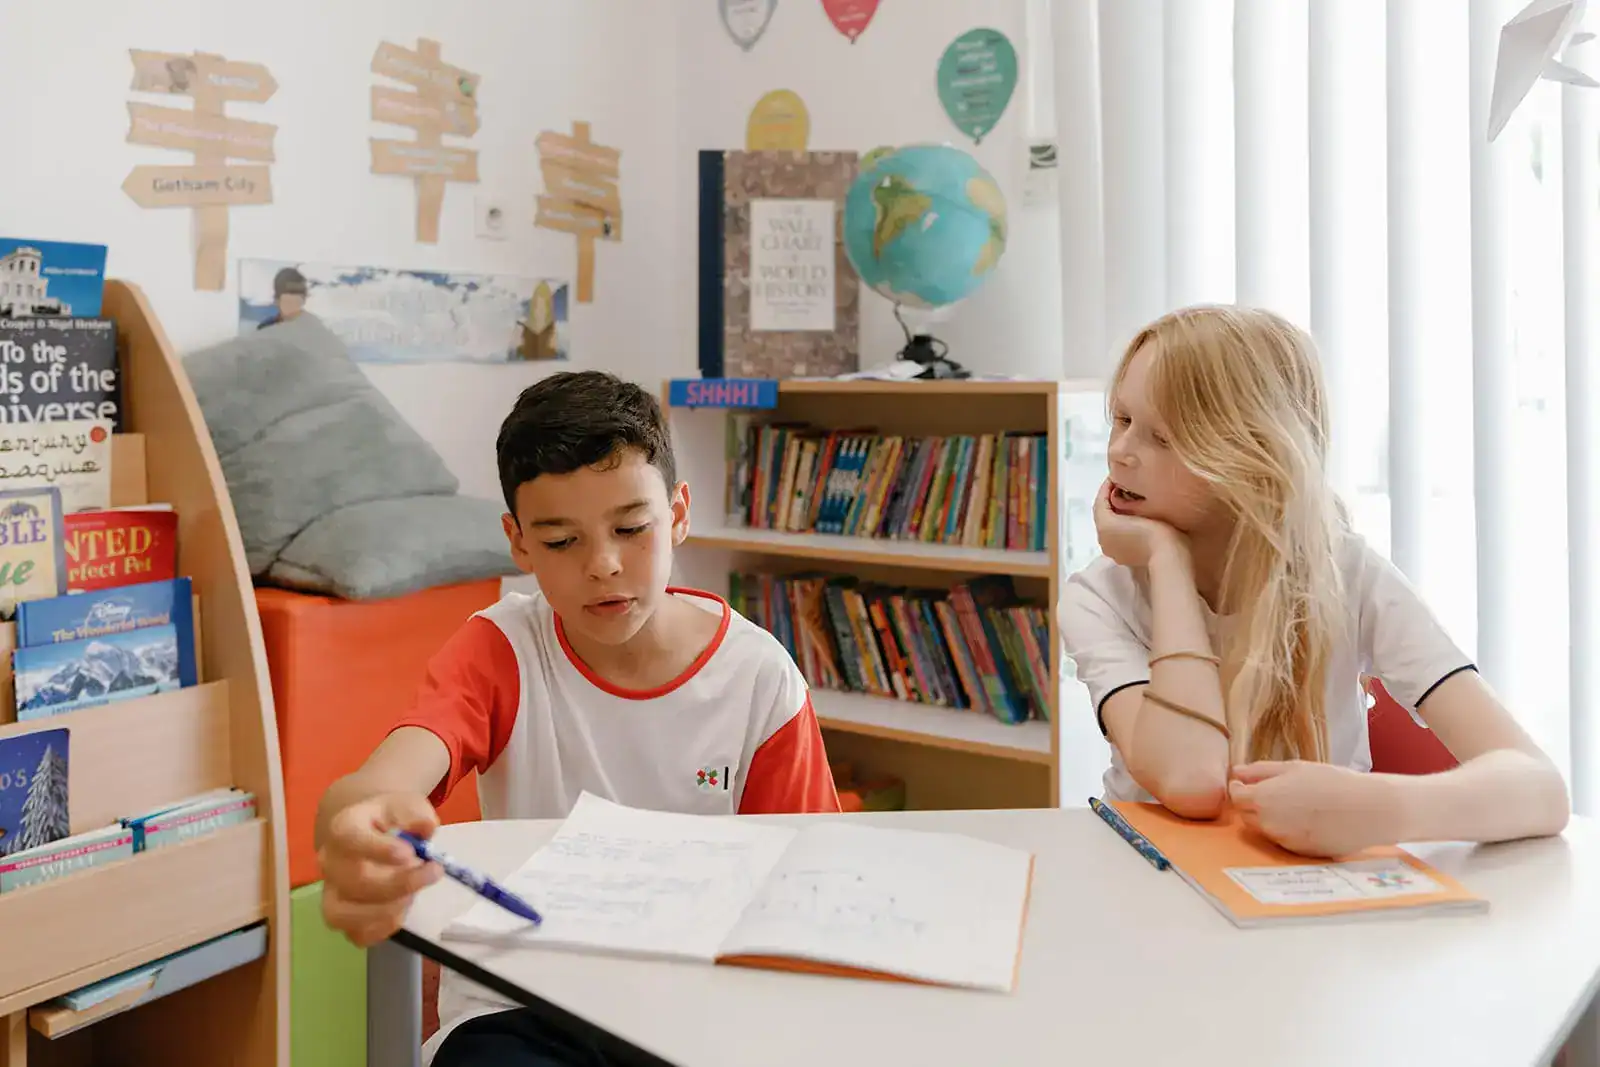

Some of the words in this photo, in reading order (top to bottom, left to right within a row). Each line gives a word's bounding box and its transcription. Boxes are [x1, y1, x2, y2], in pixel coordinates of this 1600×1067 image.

[152, 177, 220, 193] Gotham
[224, 175, 257, 194] City
[767, 217, 815, 233] WALL
[759, 233, 824, 251] CHART
[758, 265, 829, 281] WORLD
[754, 281, 828, 298] HISTORY
[0, 340, 25, 363] To
[32, 340, 67, 363] the
[30, 363, 65, 394] of
[69, 362, 116, 392] the
[69, 561, 116, 582] rfect
[123, 556, 152, 576] Pet
[51, 627, 76, 643] The
